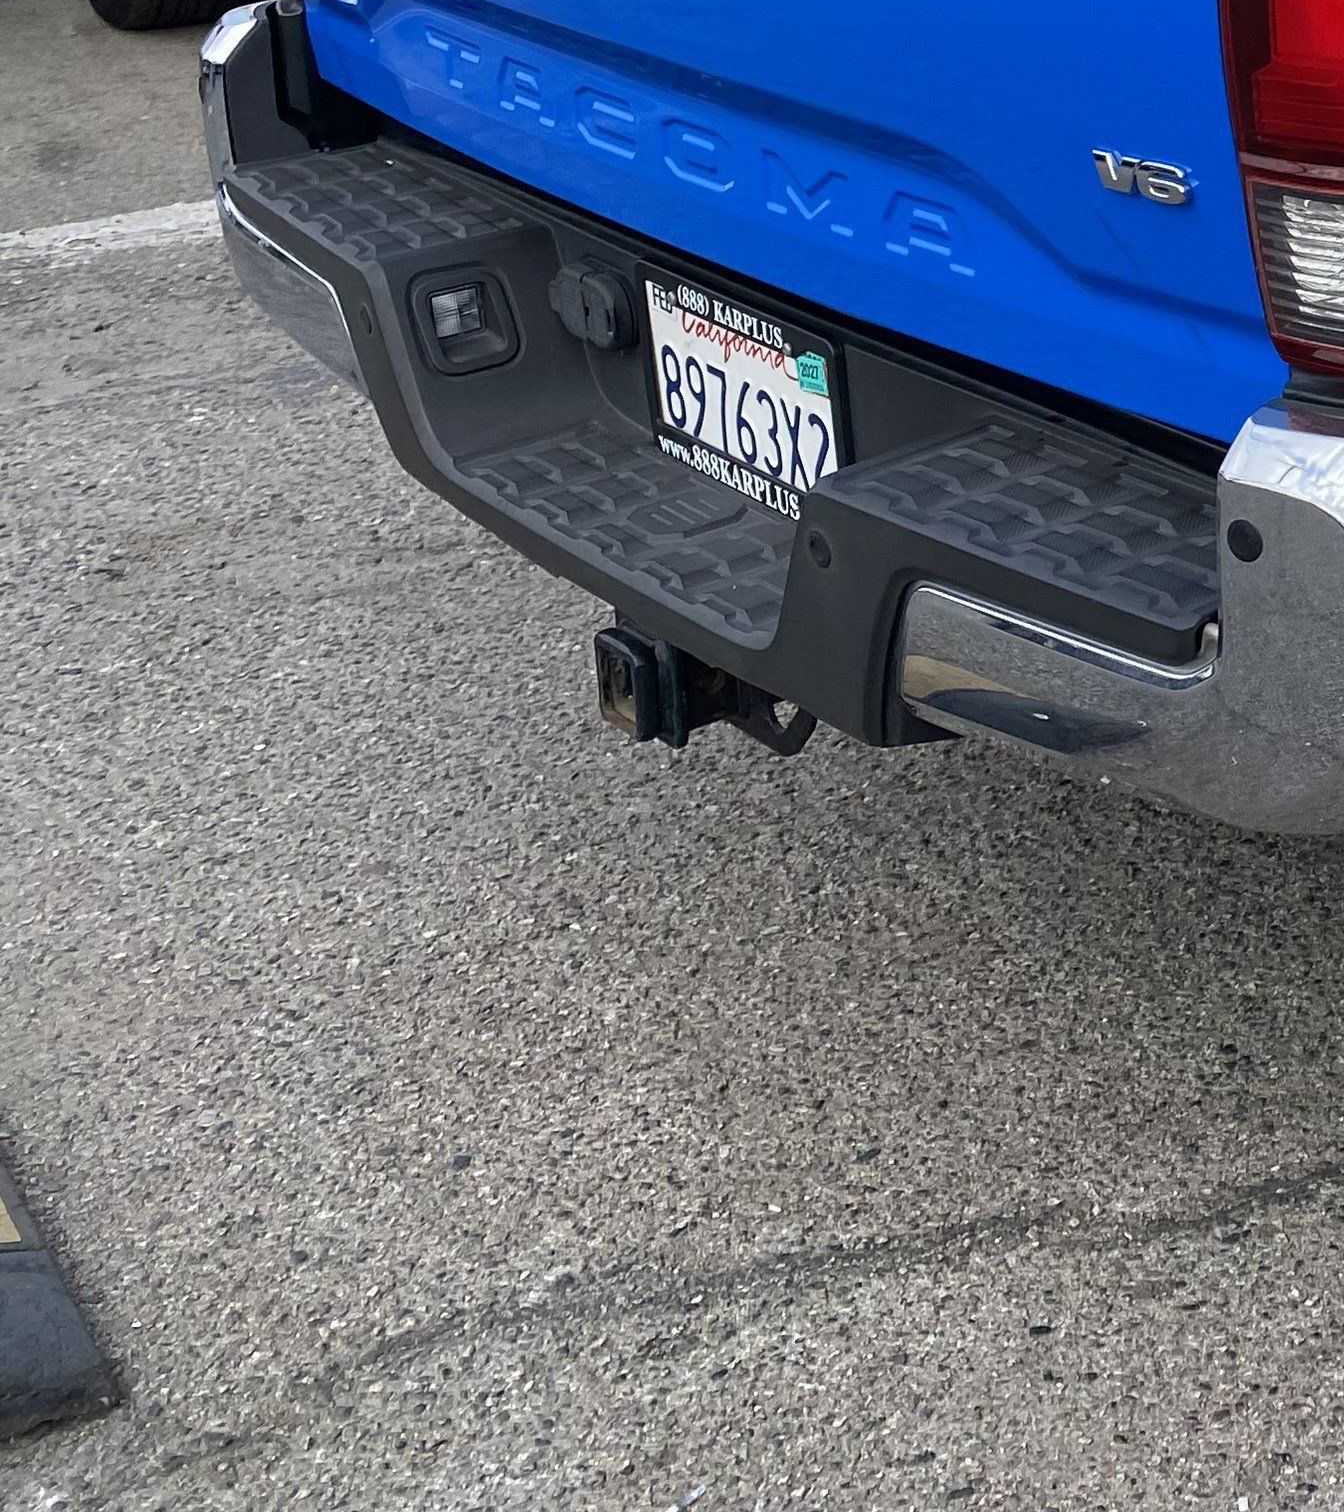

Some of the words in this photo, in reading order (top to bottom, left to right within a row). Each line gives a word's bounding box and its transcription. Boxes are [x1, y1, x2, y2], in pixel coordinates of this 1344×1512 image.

[425, 25, 976, 278] TACOMA
[1091, 148, 1187, 205] V6
[677, 284, 709, 317] (888)
[713, 299, 784, 349] KARPLUS
[681, 310, 799, 382] California
[661, 343, 830, 493] 89763X2
